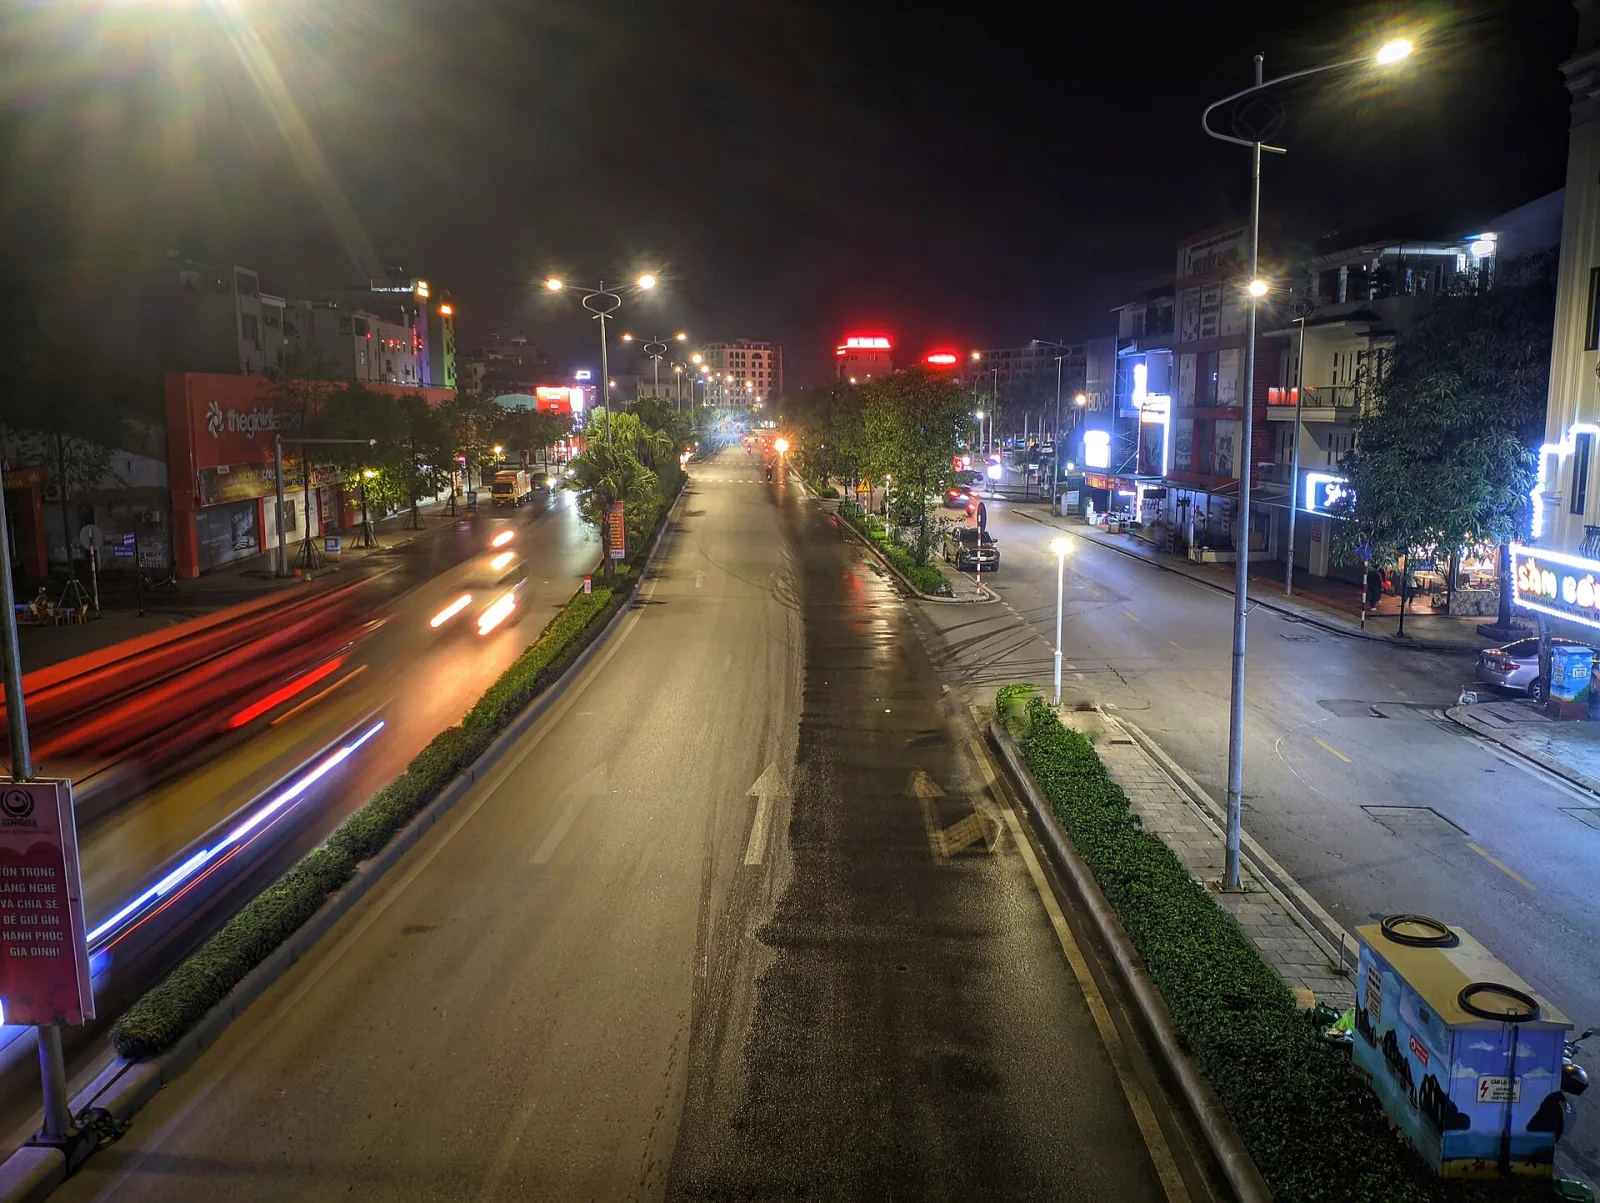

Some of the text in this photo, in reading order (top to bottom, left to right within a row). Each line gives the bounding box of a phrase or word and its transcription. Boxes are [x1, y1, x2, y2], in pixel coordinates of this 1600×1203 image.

[20, 867, 55, 879] TRỌNG
[29, 883, 57, 893] NGHE
[1, 897, 14, 909] VÀ
[17, 900, 42, 909] CHIA
[2, 928, 64, 943] HẠNH PHÚC
[9, 945, 60, 957] GIA ĐÌNH!
